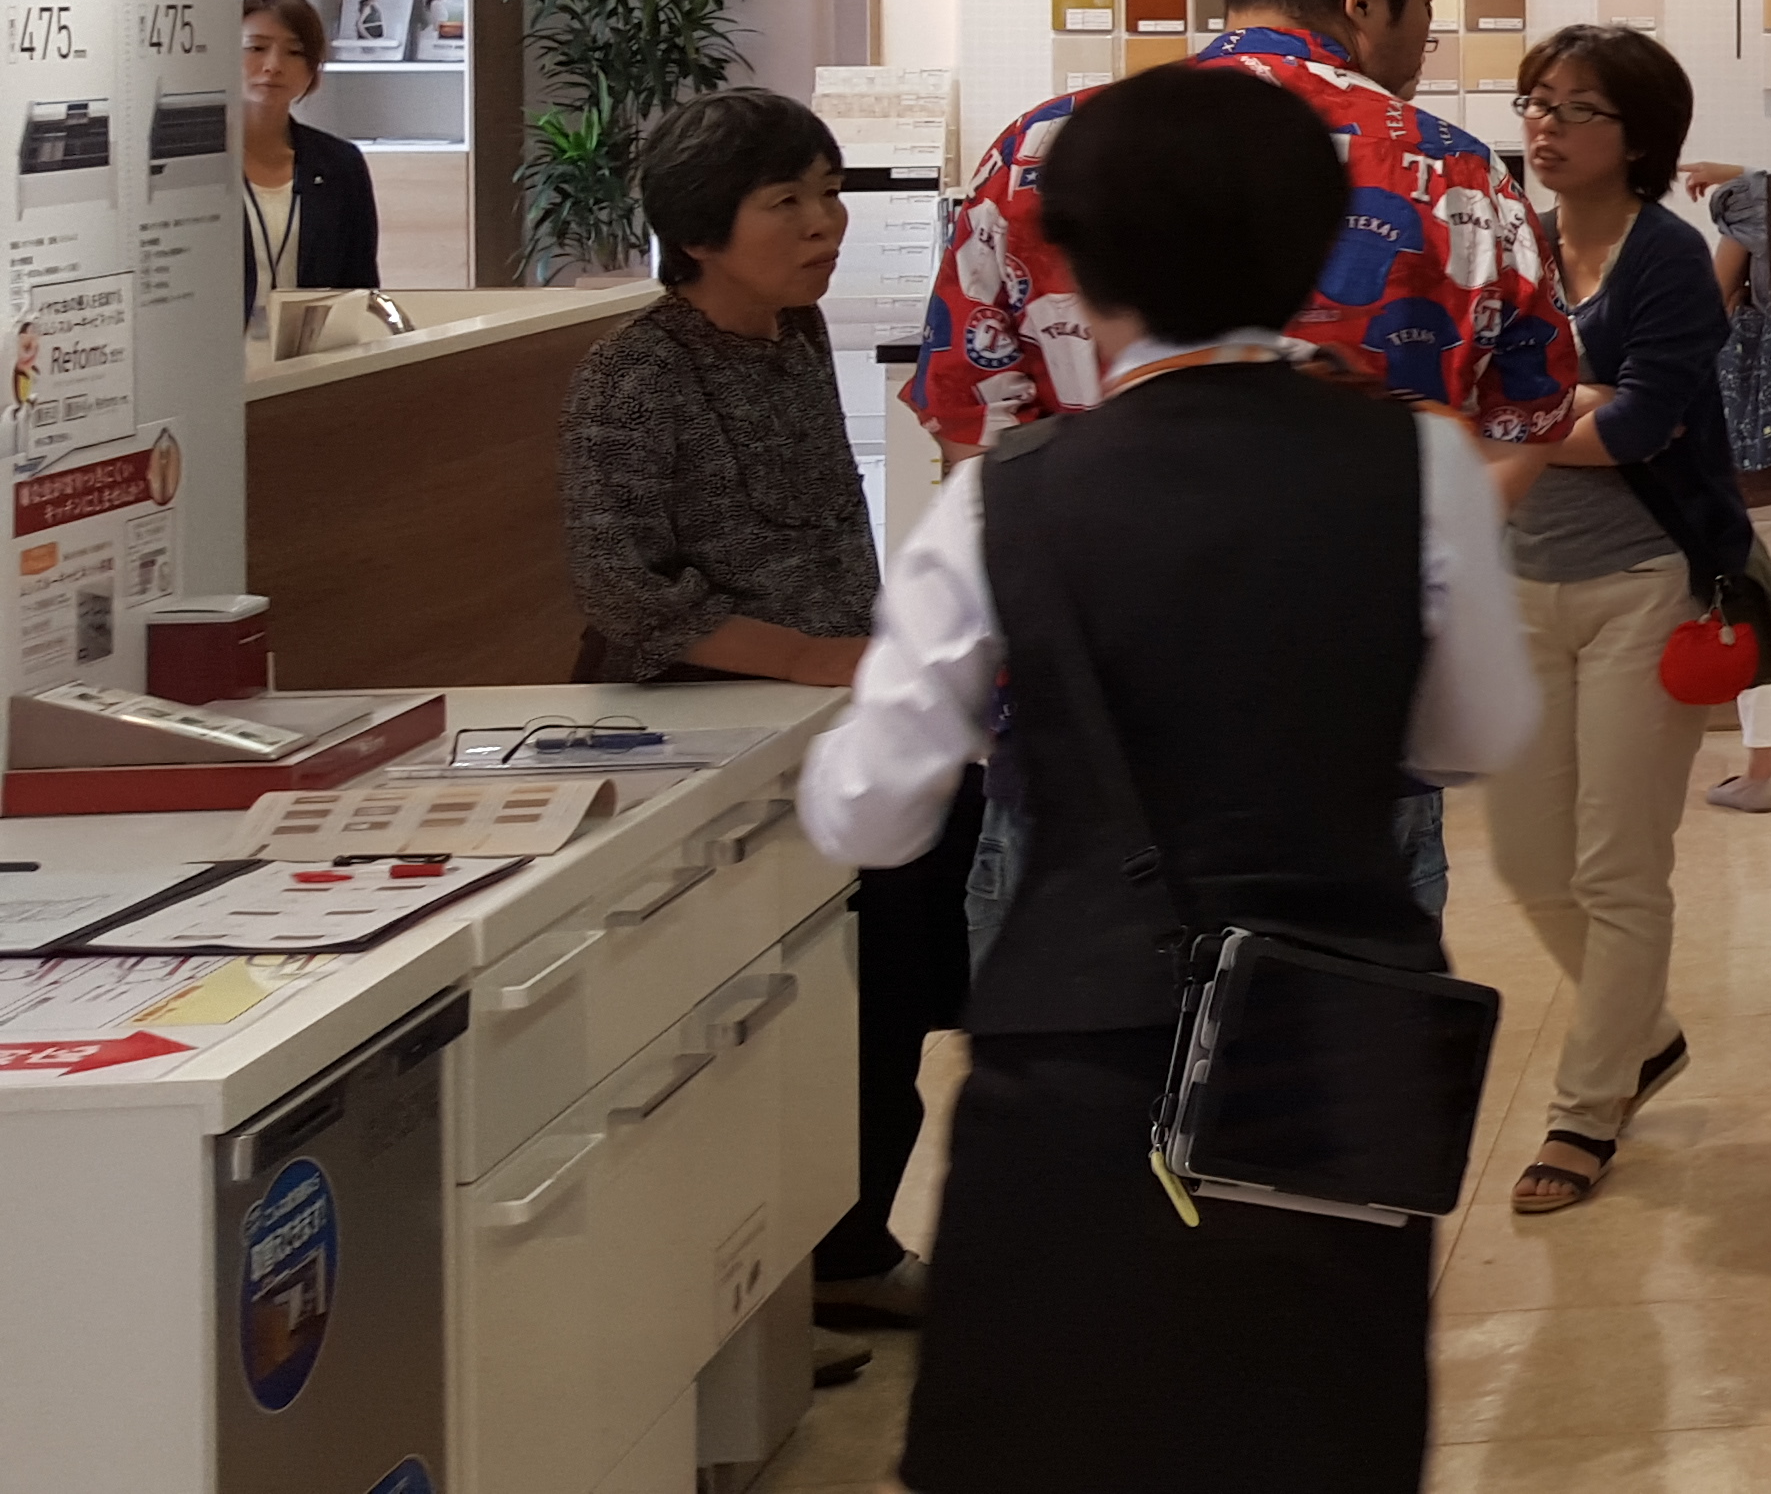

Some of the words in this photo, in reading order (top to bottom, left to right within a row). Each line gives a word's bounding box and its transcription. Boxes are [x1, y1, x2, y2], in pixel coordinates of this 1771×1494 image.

[1385, 99, 1408, 141] TEXA
[1401, 151, 1444, 203] T
[1346, 214, 1401, 242] TEXAS
[1450, 212, 1493, 231] TEXAS
[1386, 327, 1437, 346] TEXAS
